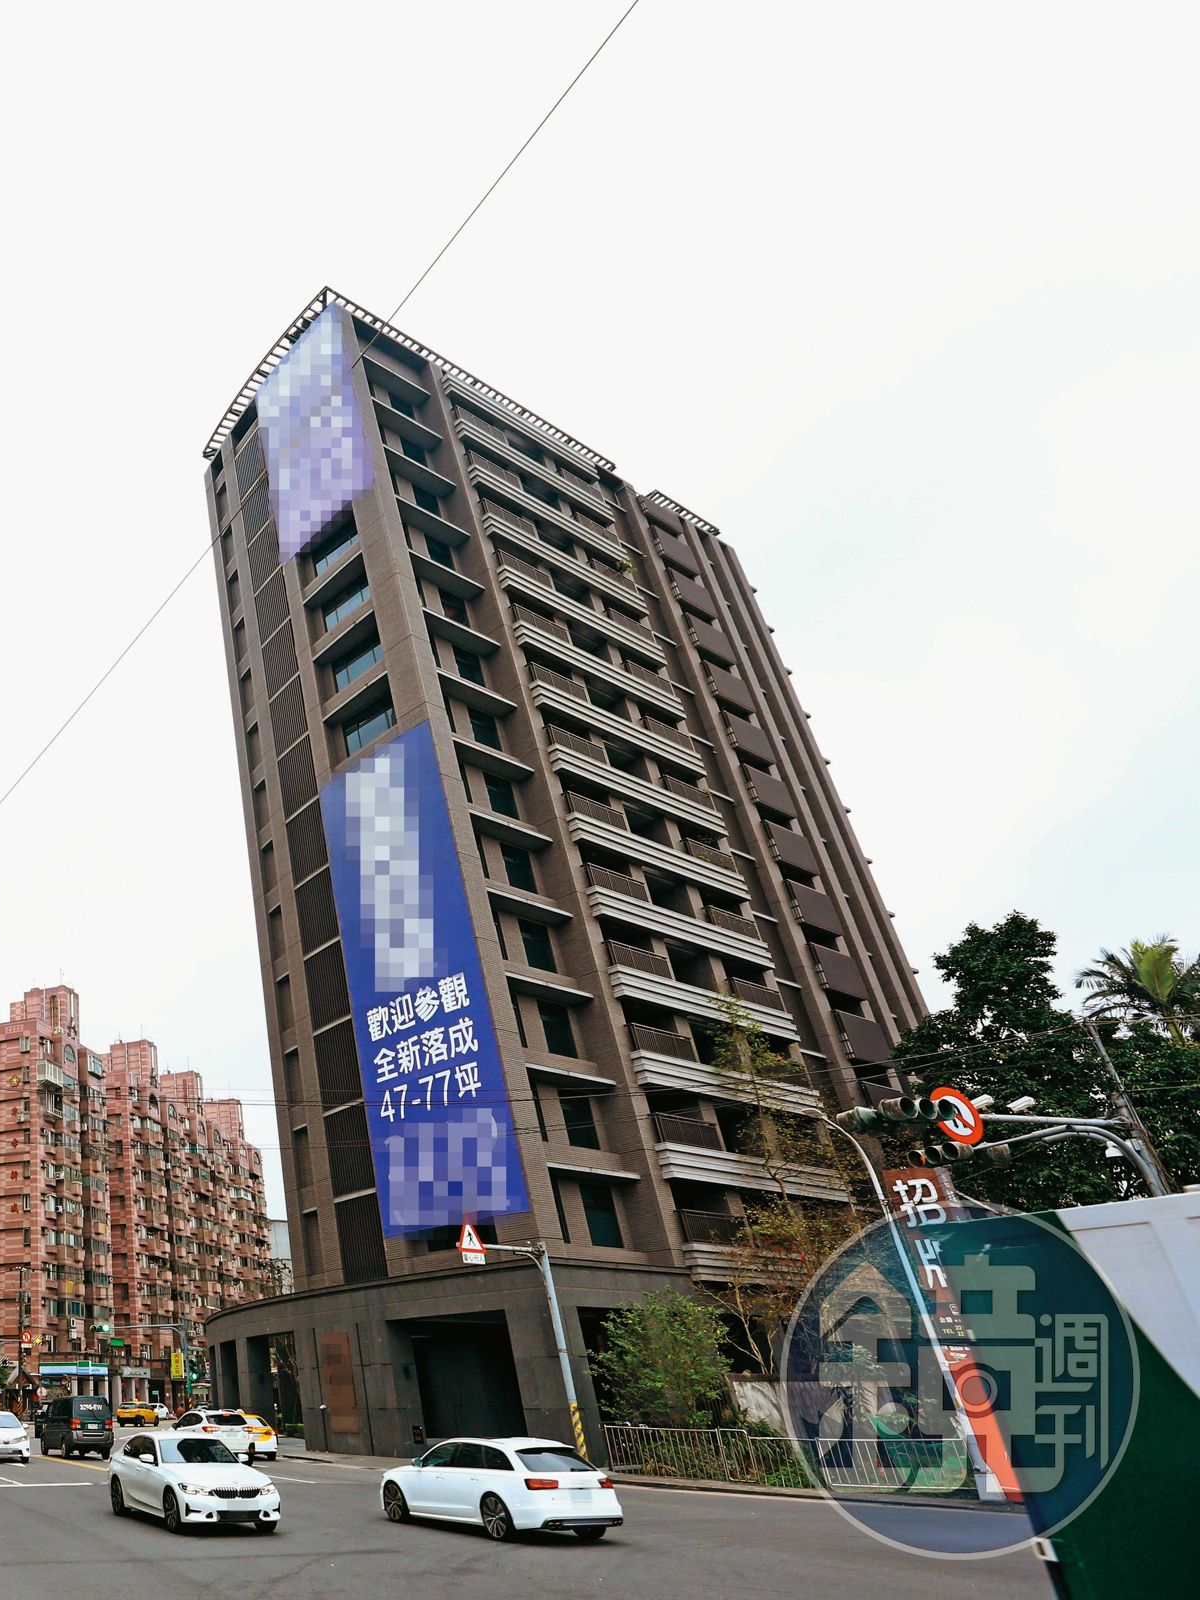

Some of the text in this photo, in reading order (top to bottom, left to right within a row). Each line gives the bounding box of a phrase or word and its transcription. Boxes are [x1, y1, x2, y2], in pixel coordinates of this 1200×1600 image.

[366, 972, 470, 1043] 歡迎參觀
[373, 1017, 479, 1085] 全新落成
[379, 1061, 482, 1123] 47-77坪
